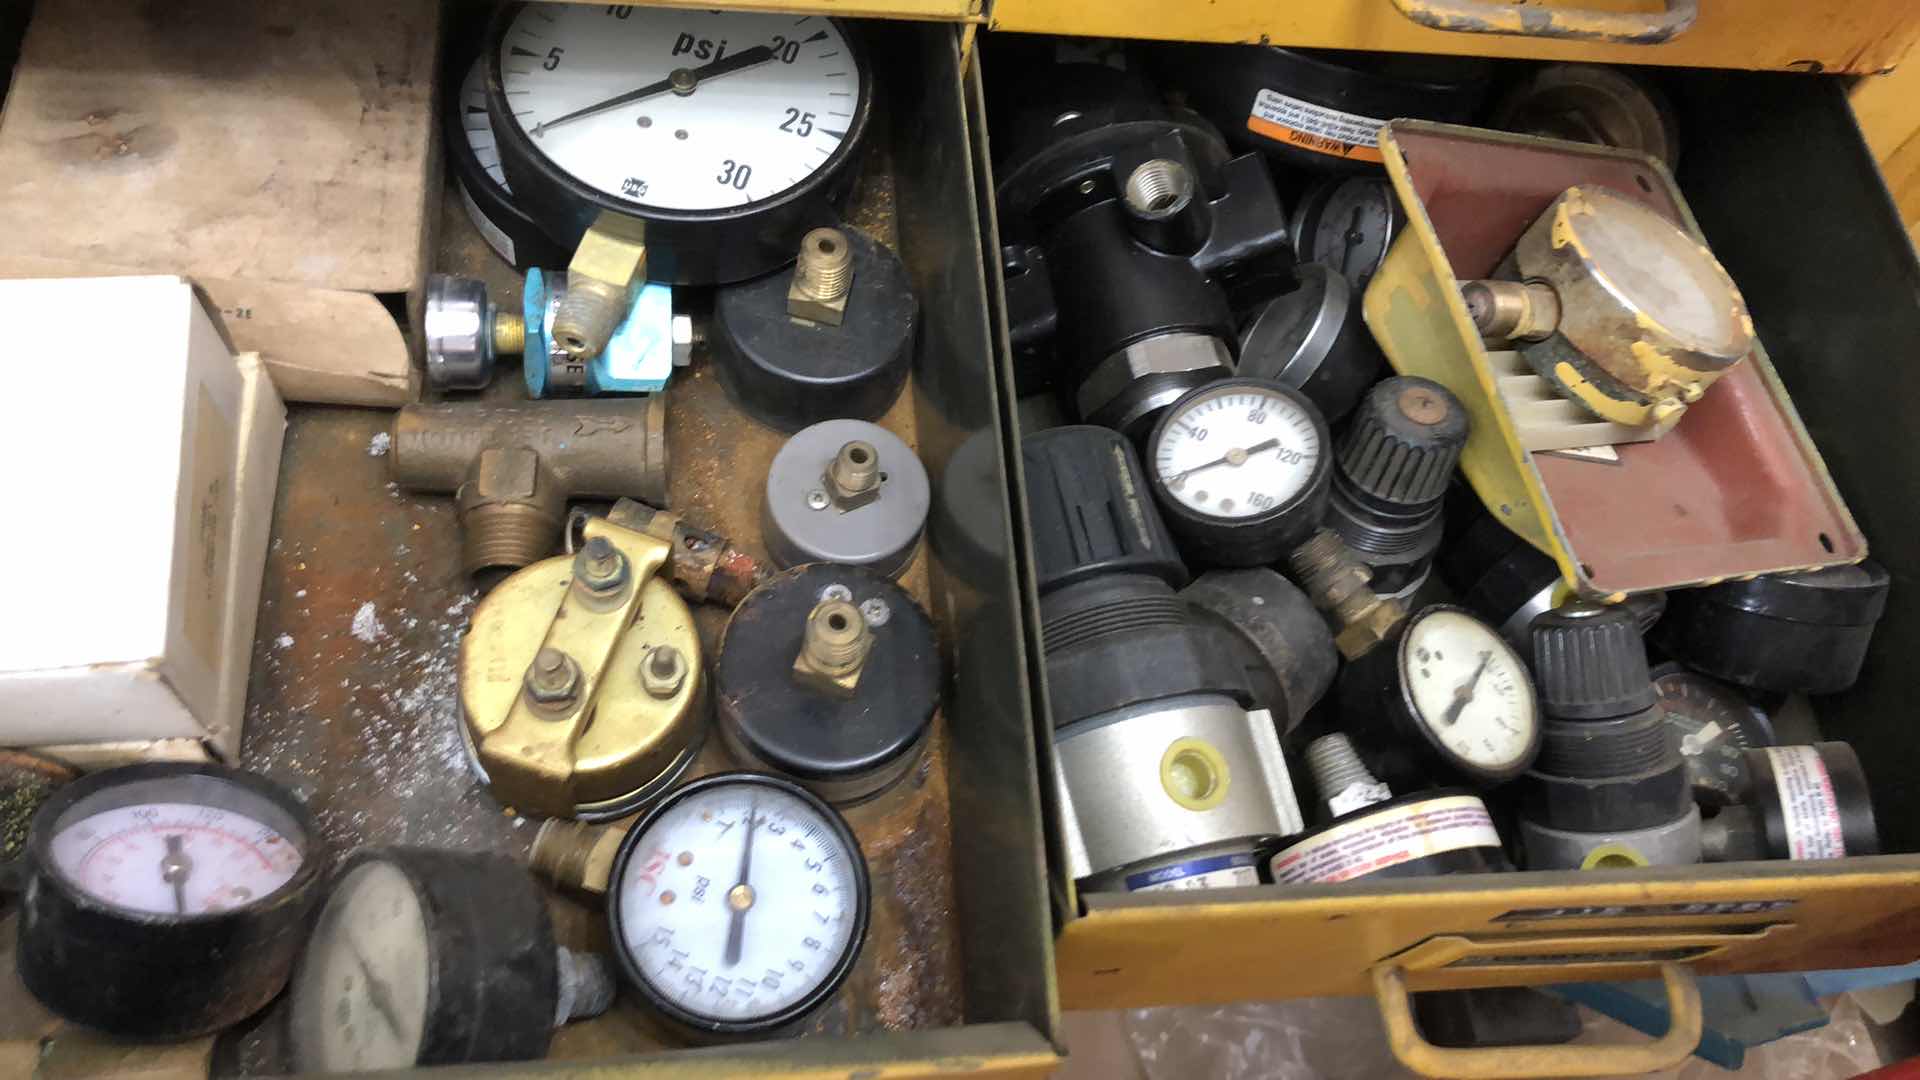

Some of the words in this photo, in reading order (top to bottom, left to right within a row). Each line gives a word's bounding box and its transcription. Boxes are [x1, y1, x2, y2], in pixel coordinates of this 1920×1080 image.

[672, 32, 727, 62] psi
[770, 35, 800, 64] 20
[543, 46, 565, 71] 5
[779, 107, 817, 138] 25
[716, 159, 752, 190] 30
[1247, 409, 1267, 425] 80
[1188, 426, 1209, 441] 40
[1276, 447, 1301, 466] 120
[1246, 491, 1275, 511] 160
[768, 823, 785, 836] 3
[790, 838, 806, 851] 4
[806, 857, 822, 872] 5
[811, 882, 828, 895] 6
[814, 911, 830, 924] 7
[653, 925, 675, 949] 15
[802, 936, 822, 951] 8
[667, 949, 690, 971] 14
[787, 957, 805, 973] 9
[761, 967, 785, 991] 10
